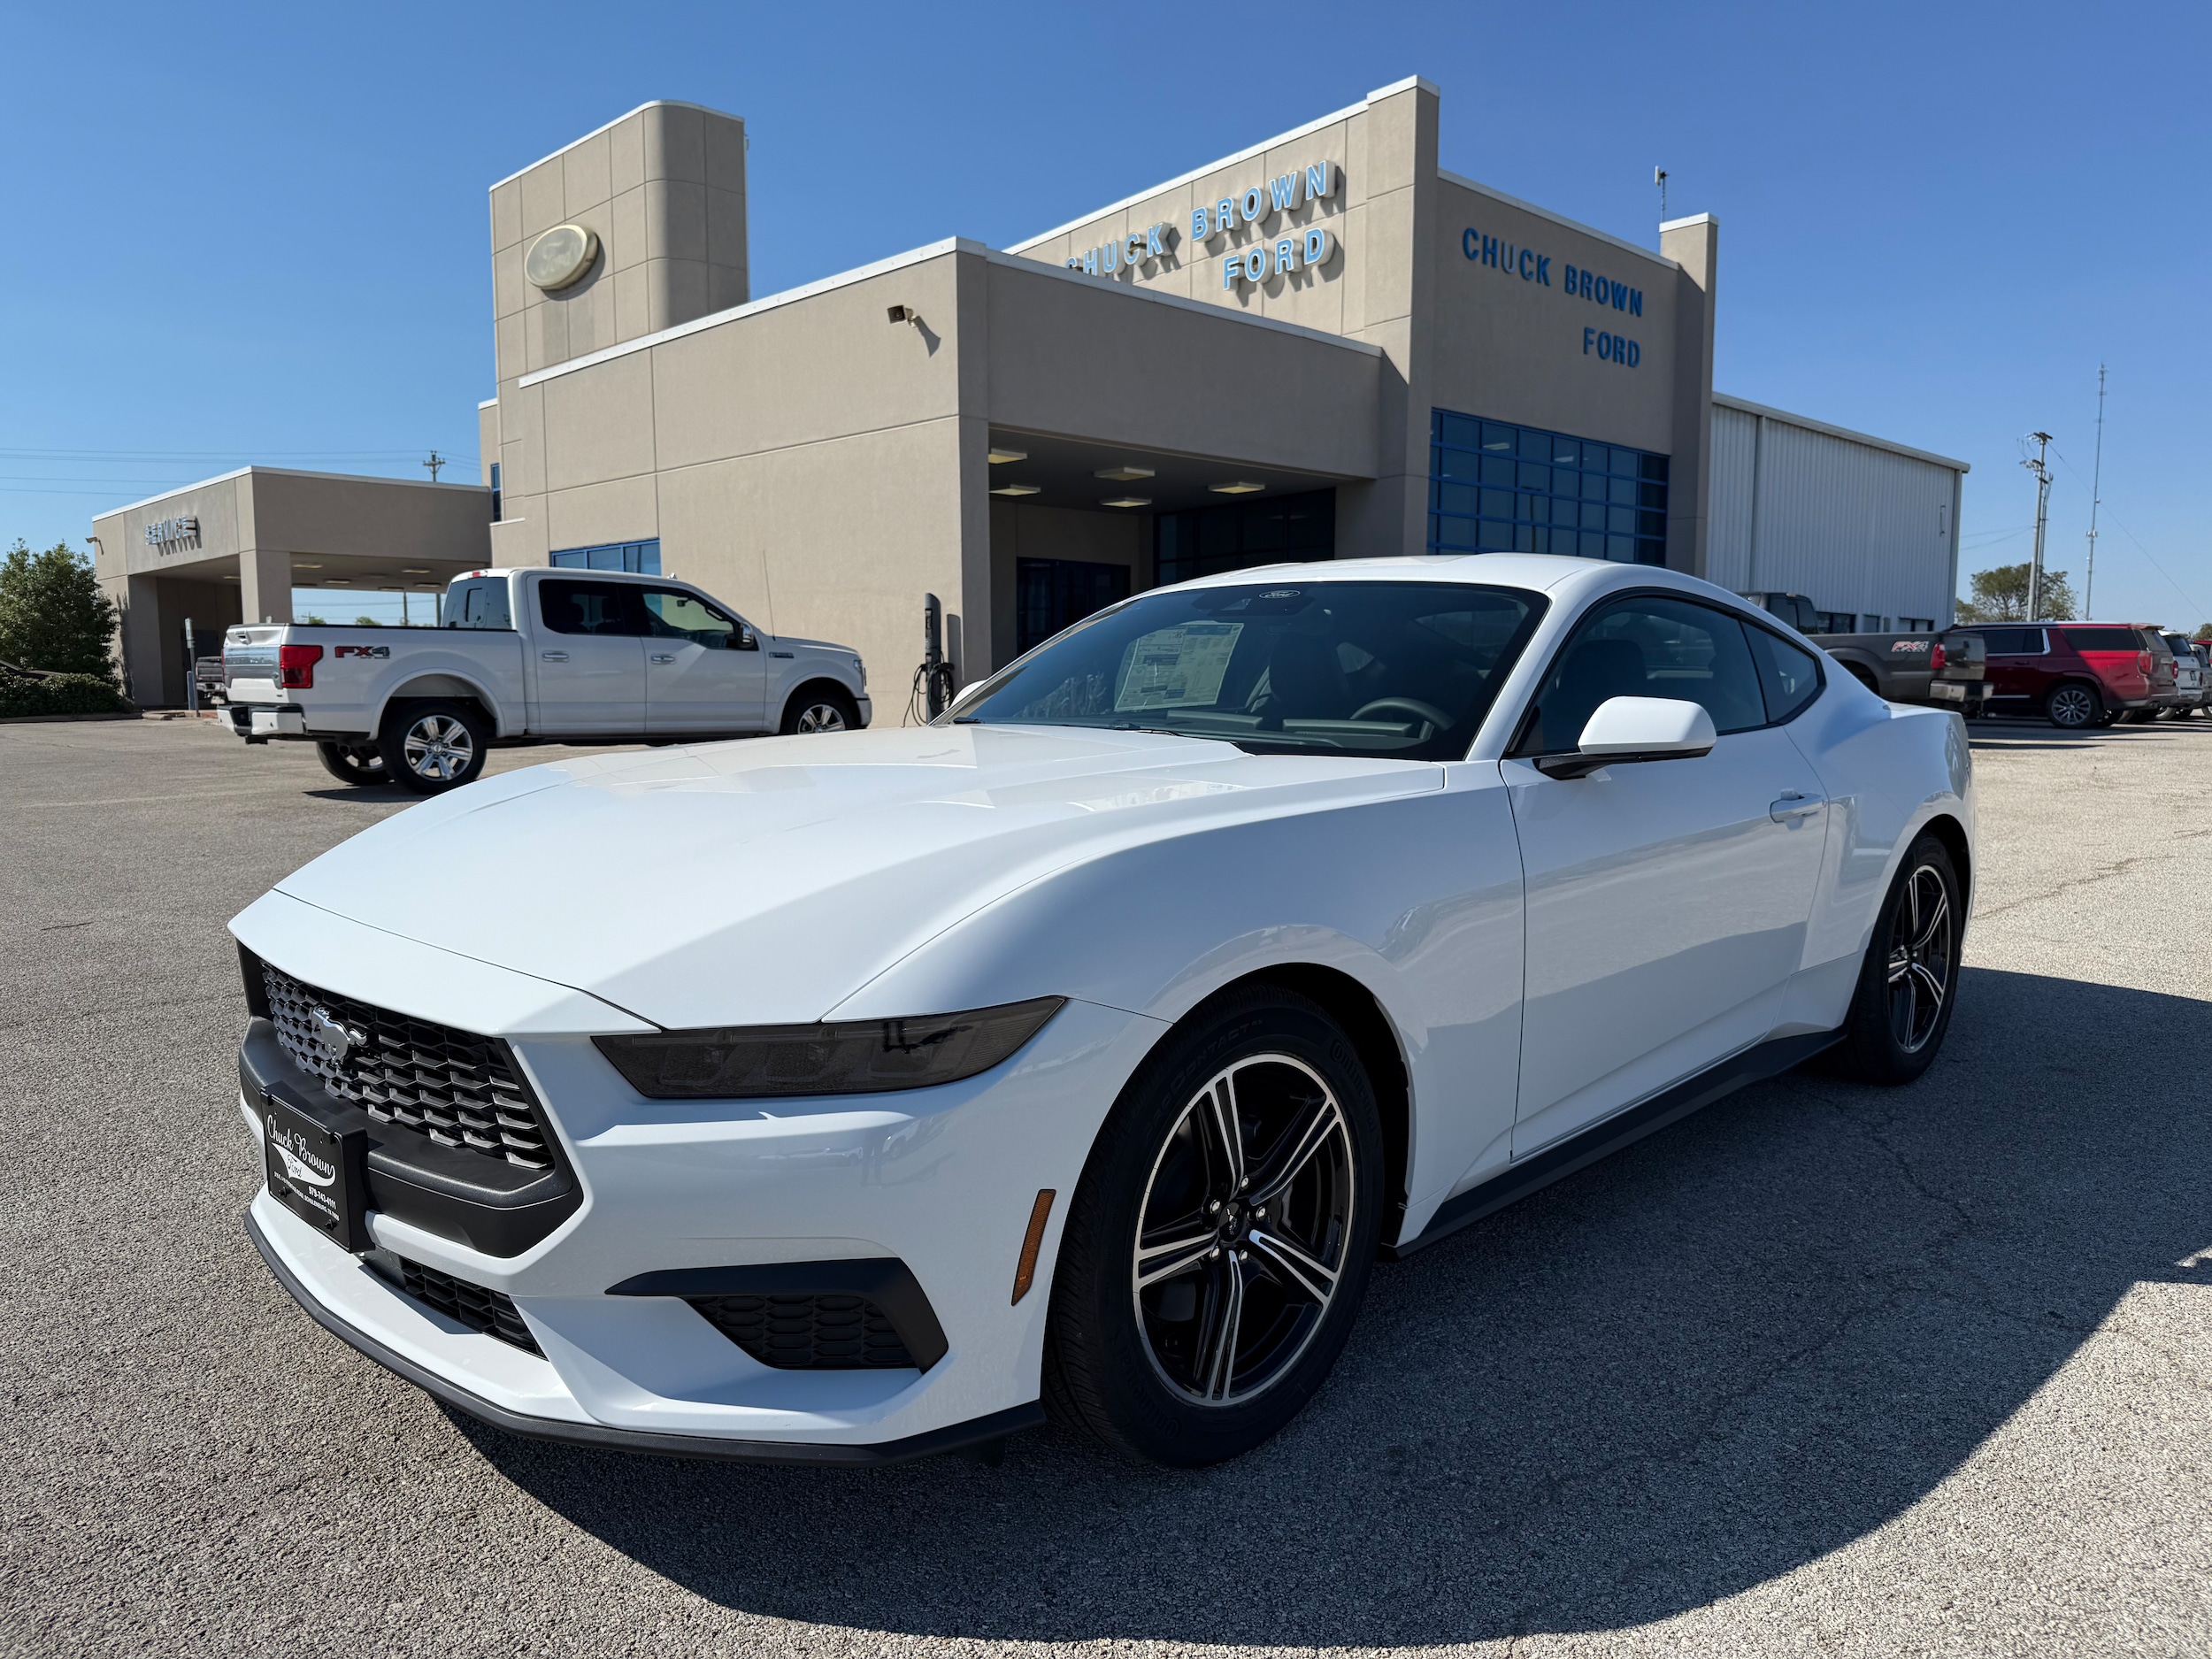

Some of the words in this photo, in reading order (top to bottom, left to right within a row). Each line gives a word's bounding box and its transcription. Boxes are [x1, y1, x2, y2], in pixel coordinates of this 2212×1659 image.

[1191, 160, 1331, 242] BROWN
[1223, 227, 1330, 291] FORD
[1463, 227, 1551, 287] CHUCK
[1564, 265, 1644, 317] BROWN
[1583, 326, 1641, 368] FORD
[144, 515, 196, 545] SERVICE
[334, 646, 390, 658] FX4
[1891, 641, 1929, 652] FX4
[267, 1115, 294, 1150] Chuck
[294, 1133, 334, 1176] Brown
[288, 1154, 302, 1178] Ford
